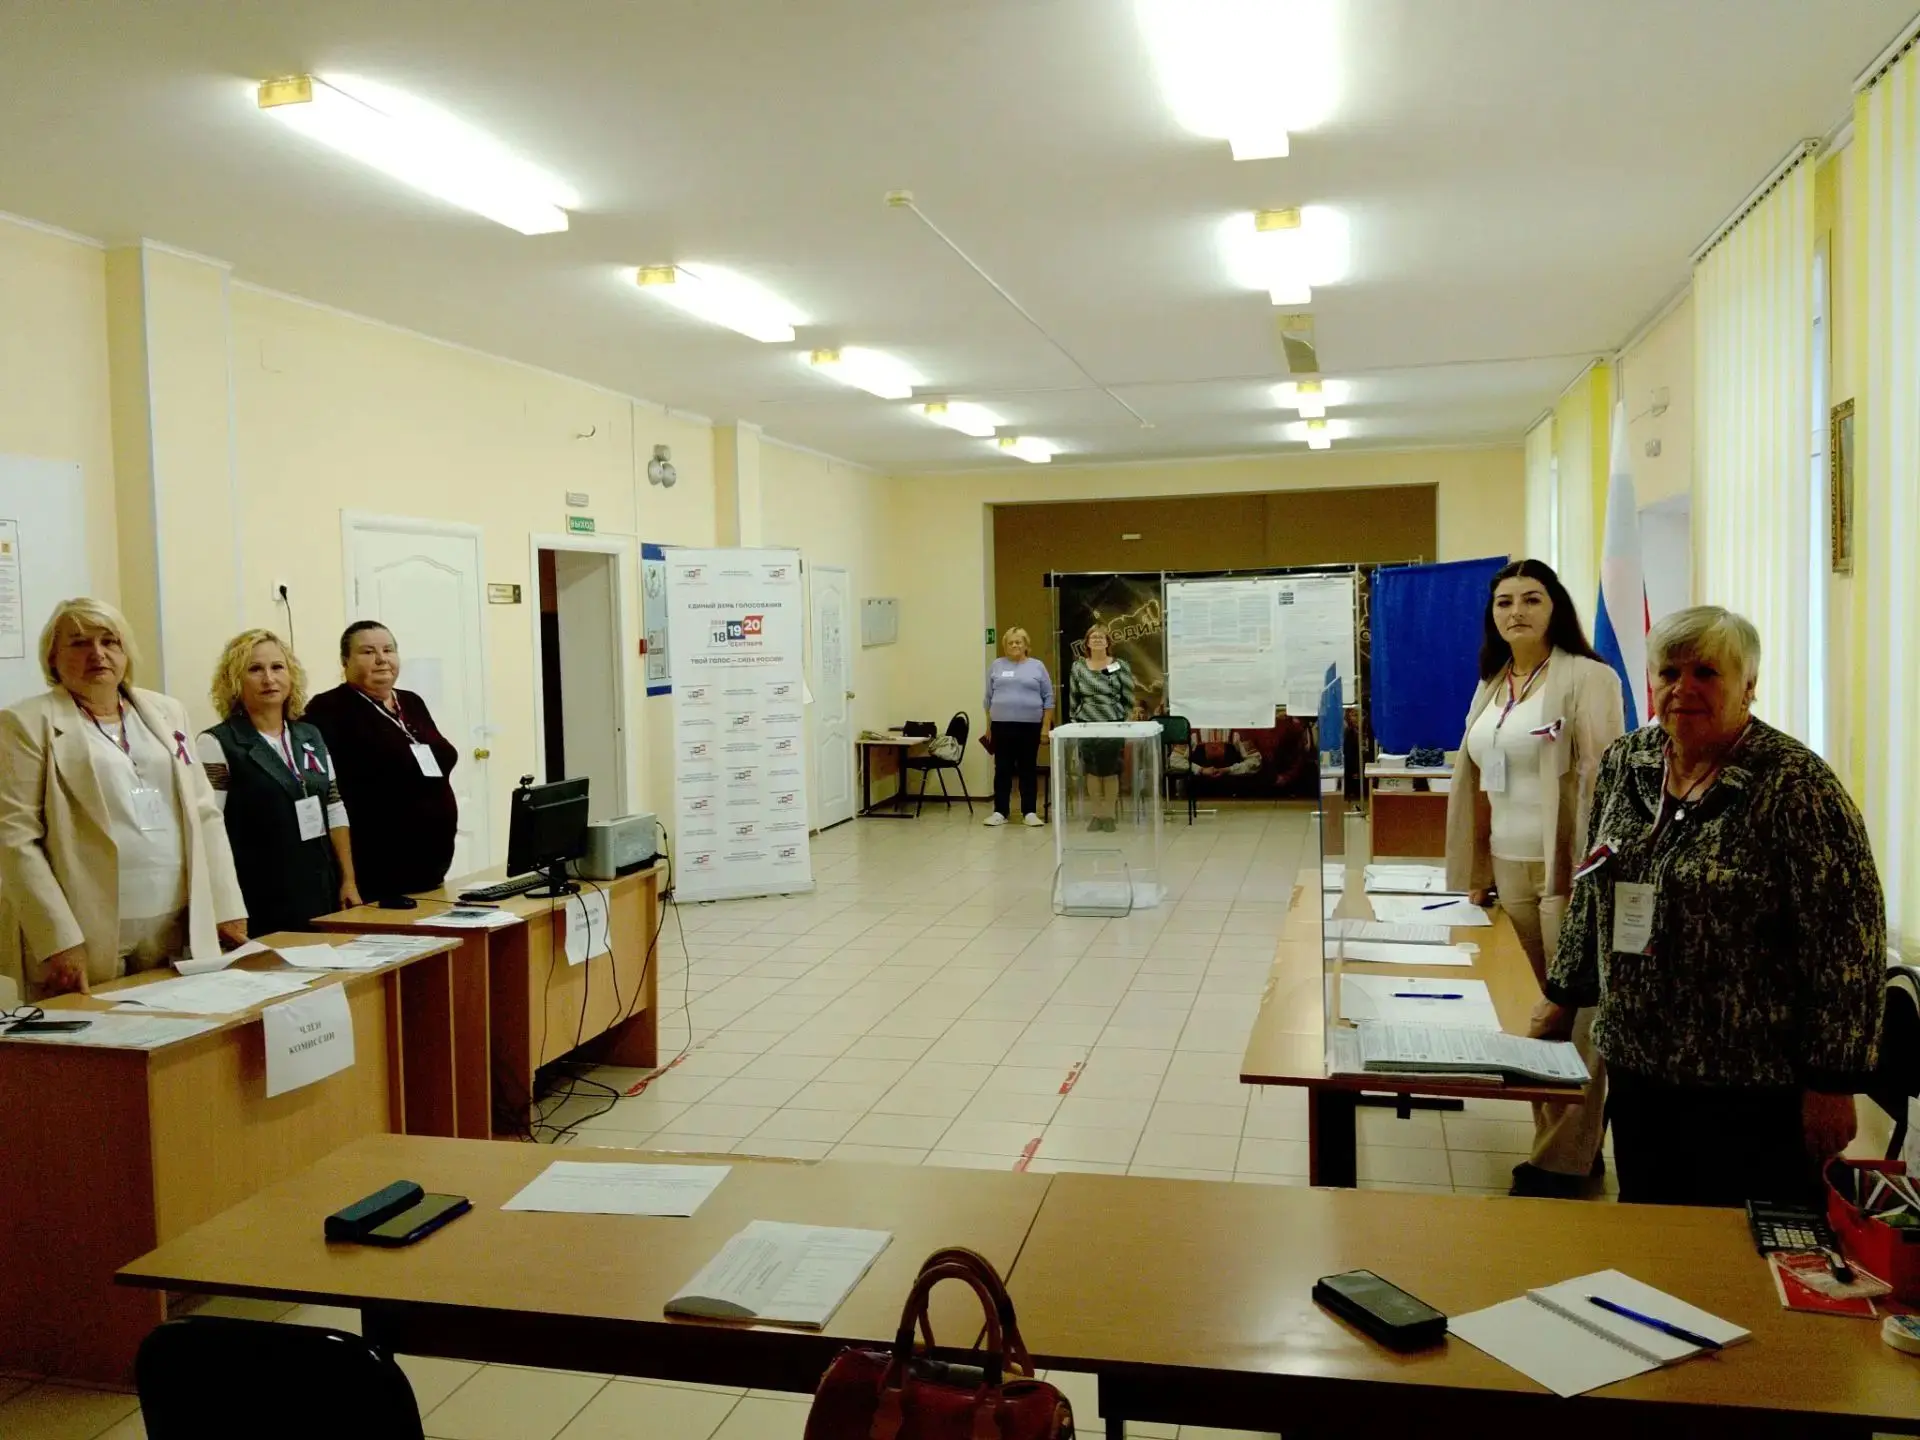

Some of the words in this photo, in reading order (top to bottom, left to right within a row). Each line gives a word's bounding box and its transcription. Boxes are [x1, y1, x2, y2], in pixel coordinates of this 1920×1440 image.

[571, 519, 594, 531] ВЫХОД
[713, 632, 726, 643] 18
[728, 624, 741, 637] 19
[744, 619, 760, 631] 20
[690, 657, 708, 665] ТВОЙ
[299, 1021, 322, 1034] ЧЛЕН
[288, 1031, 335, 1055] КОМИССИИ
